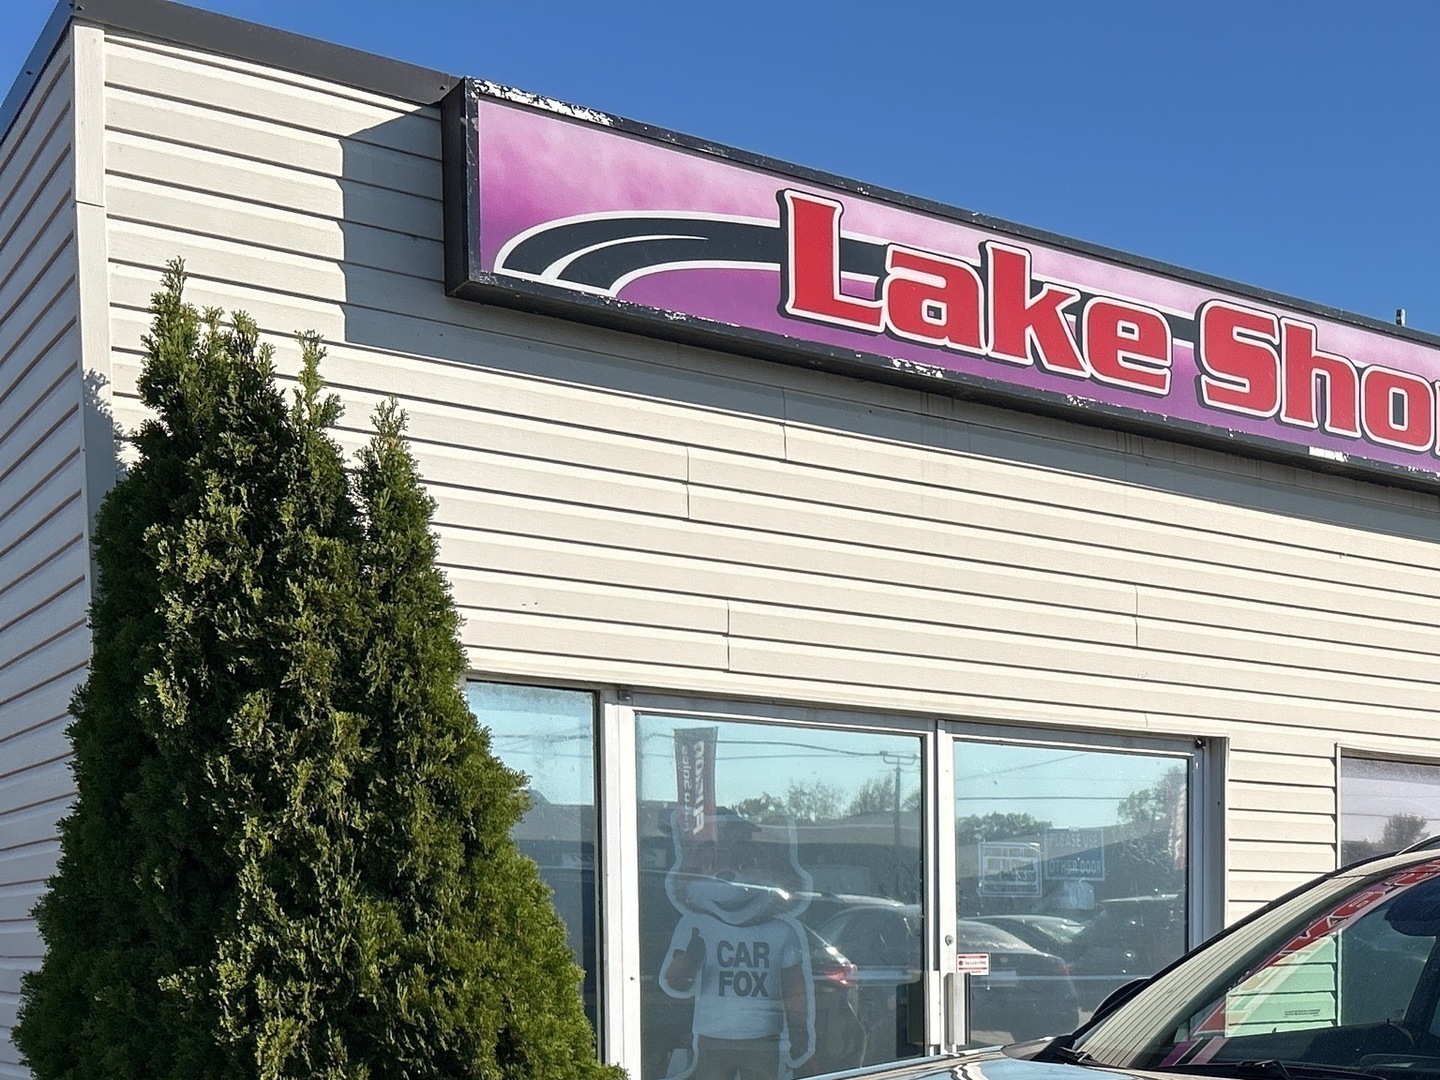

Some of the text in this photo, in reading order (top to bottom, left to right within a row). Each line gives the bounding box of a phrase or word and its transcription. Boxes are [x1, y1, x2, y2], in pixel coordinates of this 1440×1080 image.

[780, 190, 1172, 395] Lake
[717, 940, 770, 968] CAR
[718, 970, 769, 997] FOX
